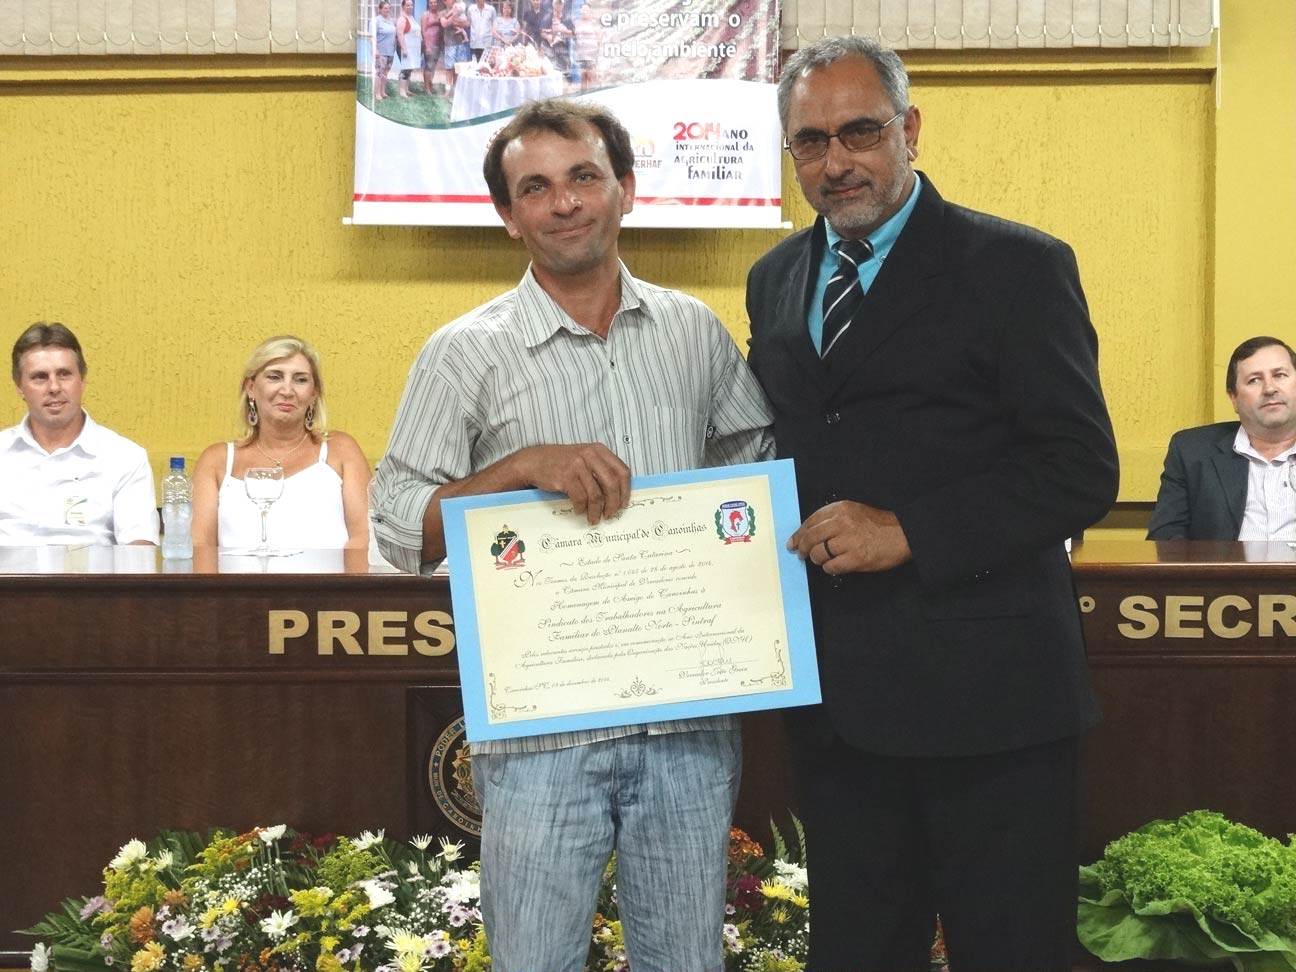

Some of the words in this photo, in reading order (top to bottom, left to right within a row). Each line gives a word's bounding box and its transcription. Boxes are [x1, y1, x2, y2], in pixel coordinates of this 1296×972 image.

[600, 13, 612, 26] e
[618, 12, 719, 31] preservam
[728, 13, 741, 27] o
[604, 41, 650, 58] meio
[652, 40, 737, 58] ambiente
[673, 122, 720, 140] 2014
[722, 129, 748, 140] ANO
[1117, 594, 1296, 640] SECR
[268, 609, 456, 657] PRES
